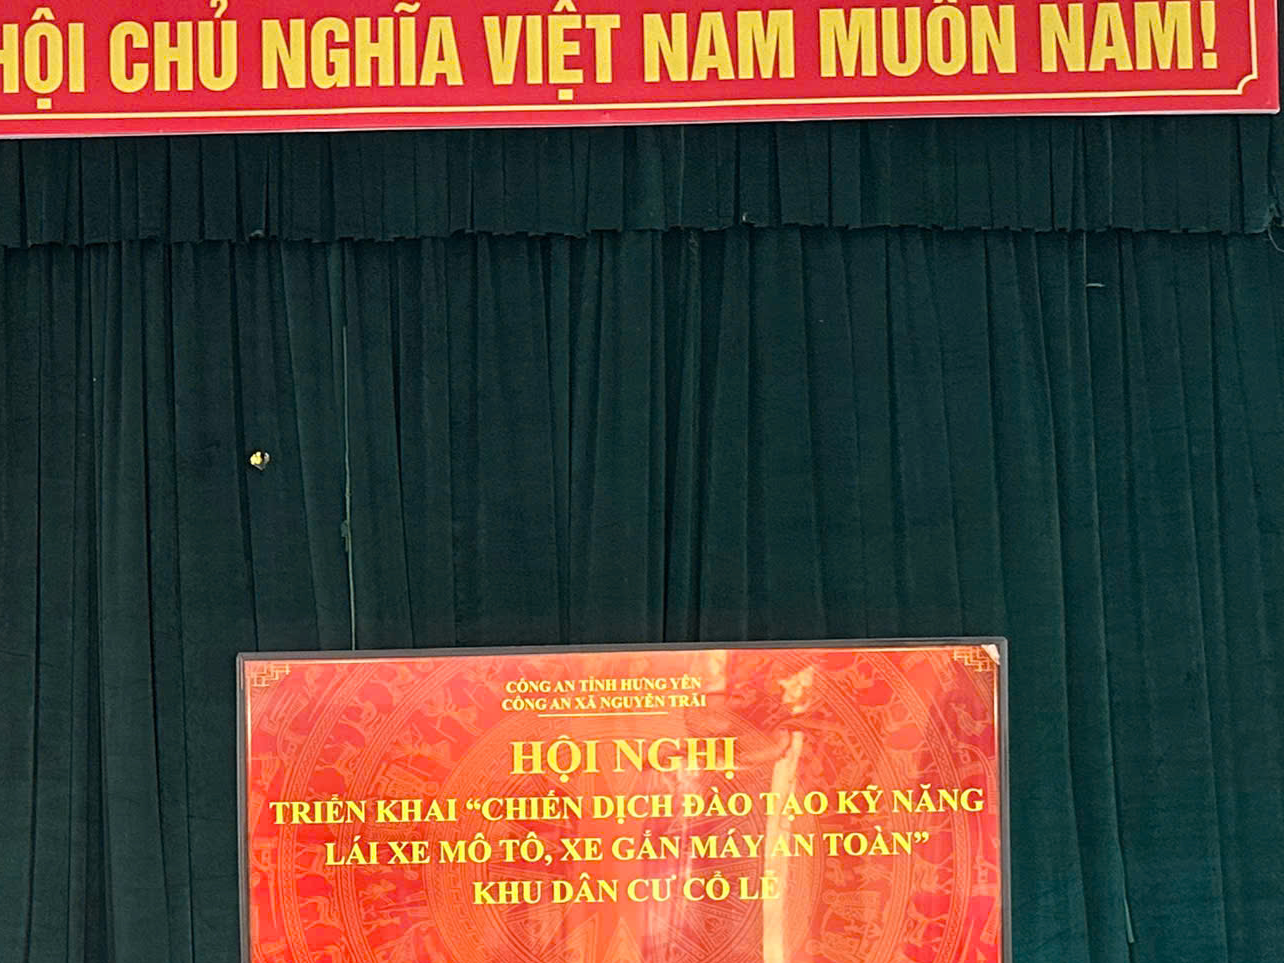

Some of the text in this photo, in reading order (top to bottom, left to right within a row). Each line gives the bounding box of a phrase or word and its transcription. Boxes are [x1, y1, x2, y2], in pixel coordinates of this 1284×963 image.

[110, 0, 238, 94] CHỦ
[263, 3, 464, 90] NGHĨA
[484, 0, 623, 101] VIỆT
[644, 11, 796, 83] NAM
[501, 696, 547, 711] CÔNG
[550, 697, 571, 710] AN
[575, 694, 596, 709] XÃ
[506, 677, 551, 693] CÔNG
[554, 679, 575, 692] AN
[620, 677, 667, 691] HƯNG
[670, 674, 702, 690] YÊN
[510, 735, 738, 783] HỘI NGHỊ
[269, 794, 367, 825] TRIỂN
[375, 799, 457, 823] KHAI
[592, 794, 672, 824] DỊCH
[682, 786, 753, 817] ĐÀO
[760, 791, 828, 821] TẠO
[838, 784, 883, 814] KỸ
[891, 783, 984, 813] NĂNG
[324, 835, 378, 866] LÁI
[387, 841, 430, 865] XE
[438, 833, 492, 864] MÔ
[499, 832, 553, 866] TÔ,
[560, 837, 603, 862] XE
[611, 829, 680, 860] GẮN
[691, 828, 764, 859] MÁY
[769, 834, 815, 857] AN
[473, 880, 543, 905] KHU
[552, 872, 619, 904] DÂN
[627, 874, 676, 902] CƯ
